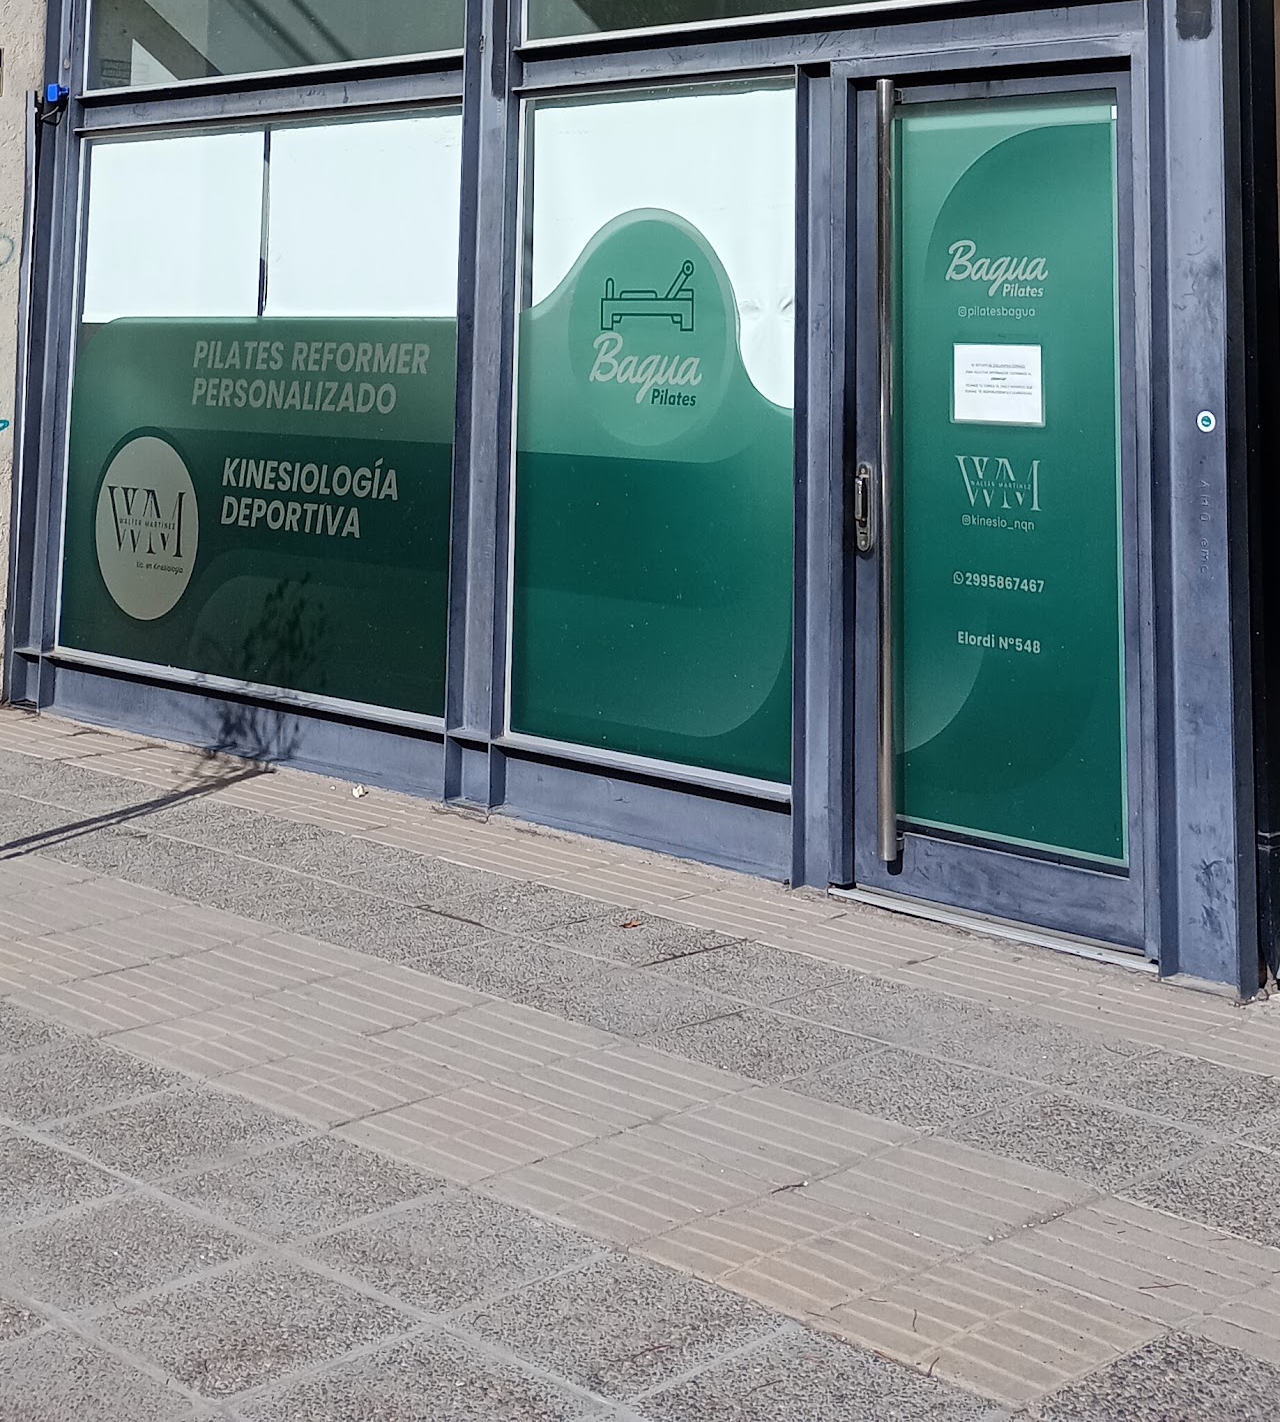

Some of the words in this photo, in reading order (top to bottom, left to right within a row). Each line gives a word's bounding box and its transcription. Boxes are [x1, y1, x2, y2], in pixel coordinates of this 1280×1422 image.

[945, 239, 1049, 297] Bagua
[1002, 283, 1045, 298] Pilates
[193, 340, 285, 371] PILATES
[291, 341, 431, 375] REFORMER
[588, 331, 703, 405] Bagua
[192, 377, 398, 415] PERSONALIZADO
[651, 388, 697, 407] Pilates
[221, 457, 399, 501] KINESIOLOGÍA
[954, 455, 1042, 512] WM
[107, 485, 186, 558] WM
[220, 495, 361, 539] DEPORTIVA
[965, 572, 1045, 593] 2995867467
[957, 631, 995, 649] Elordi
